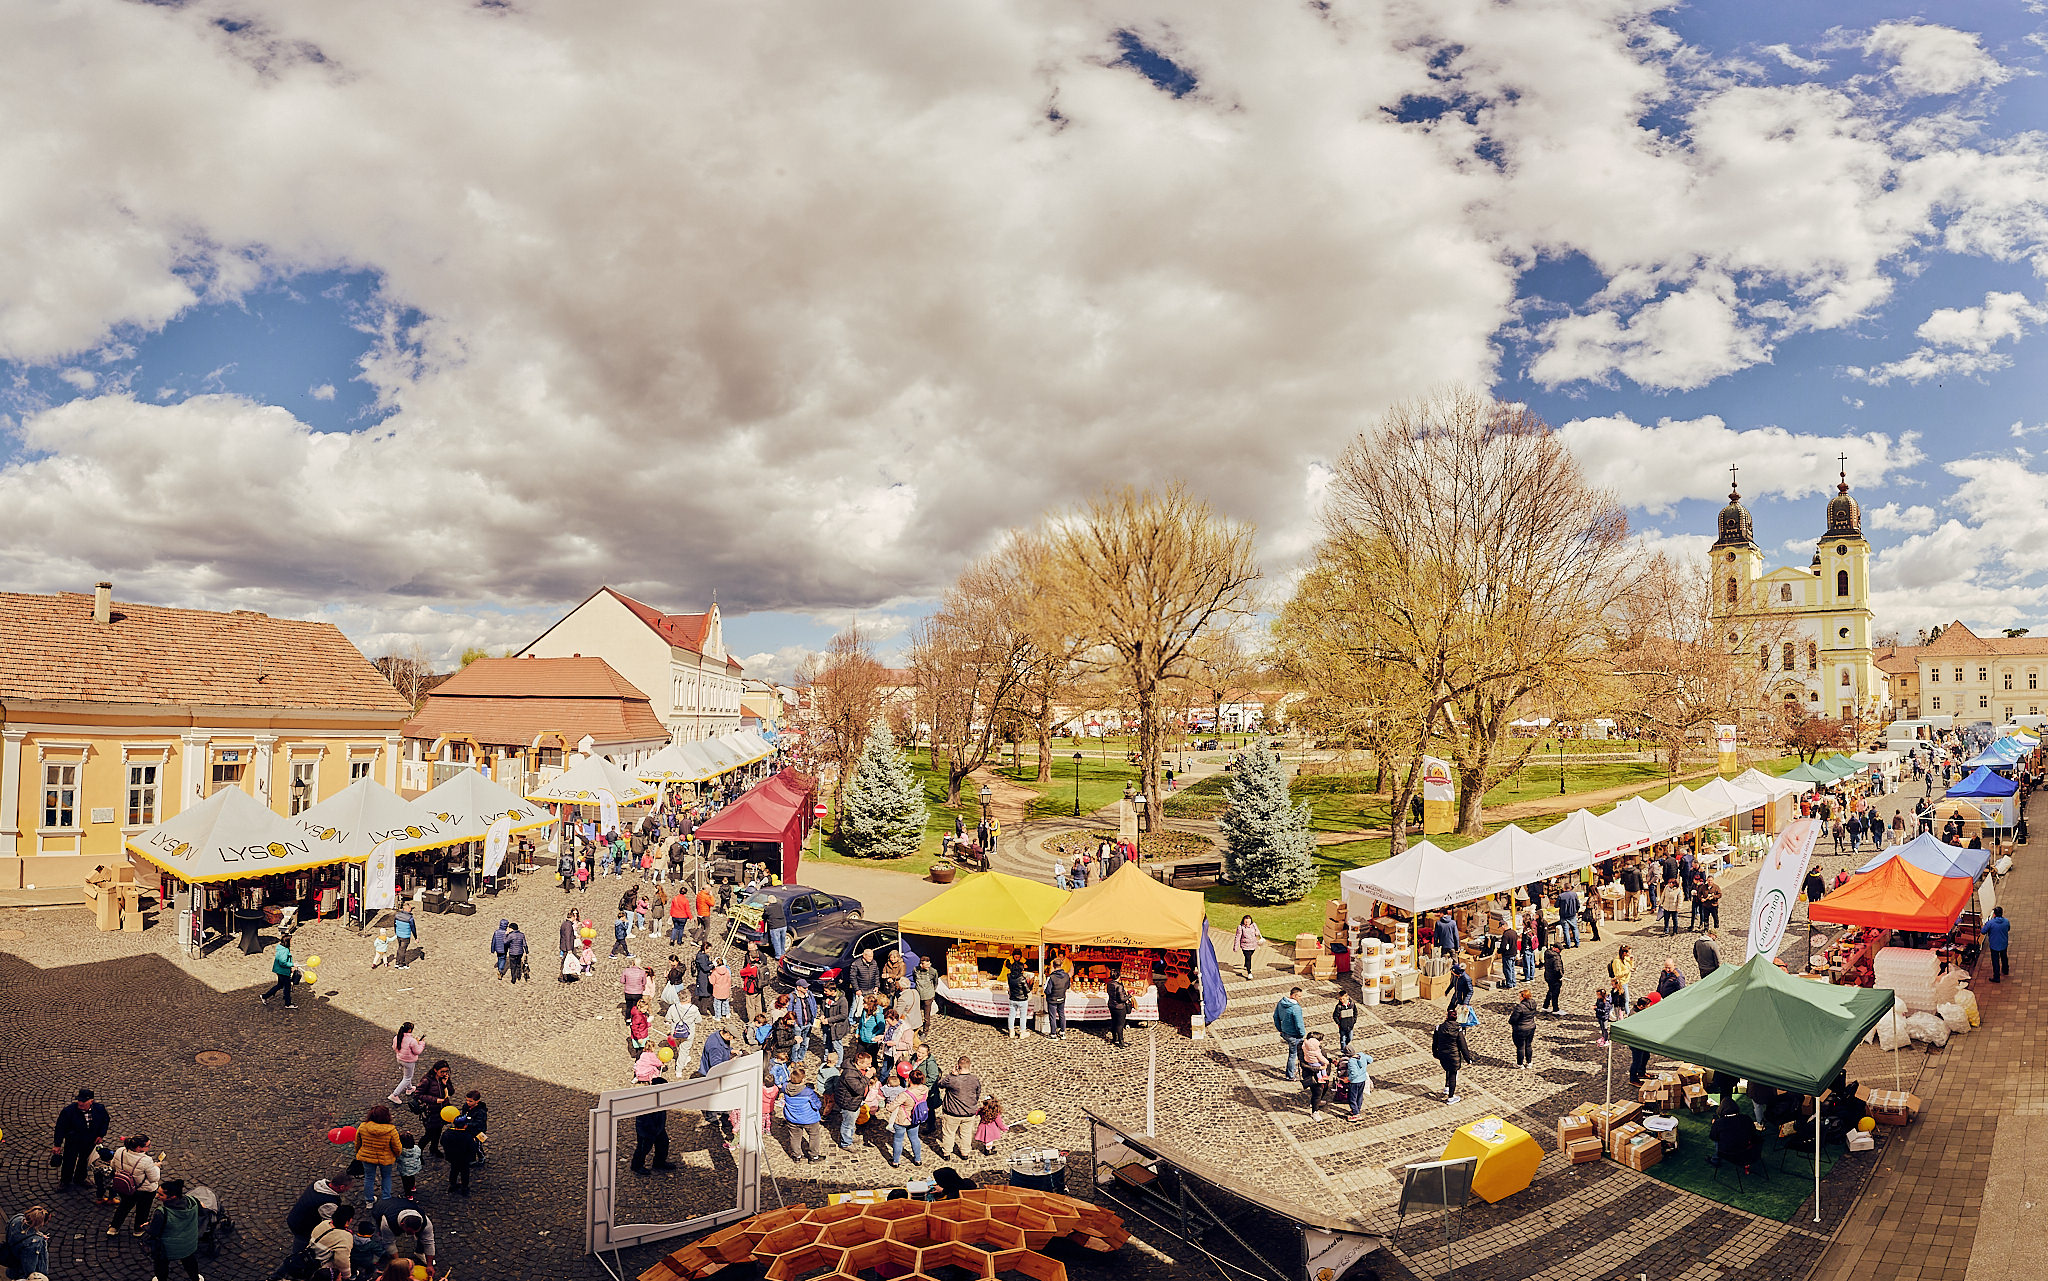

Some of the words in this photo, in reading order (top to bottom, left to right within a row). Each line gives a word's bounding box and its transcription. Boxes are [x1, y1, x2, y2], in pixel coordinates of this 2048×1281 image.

[638, 770, 684, 778] LYSON
[150, 831, 199, 861] LYSON
[218, 839, 310, 862] LYSON
[376, 854, 385, 889] LYSON
[1759, 894, 1780, 947] DULCOFRUCT
[980, 932, 1000, 941] Honey
